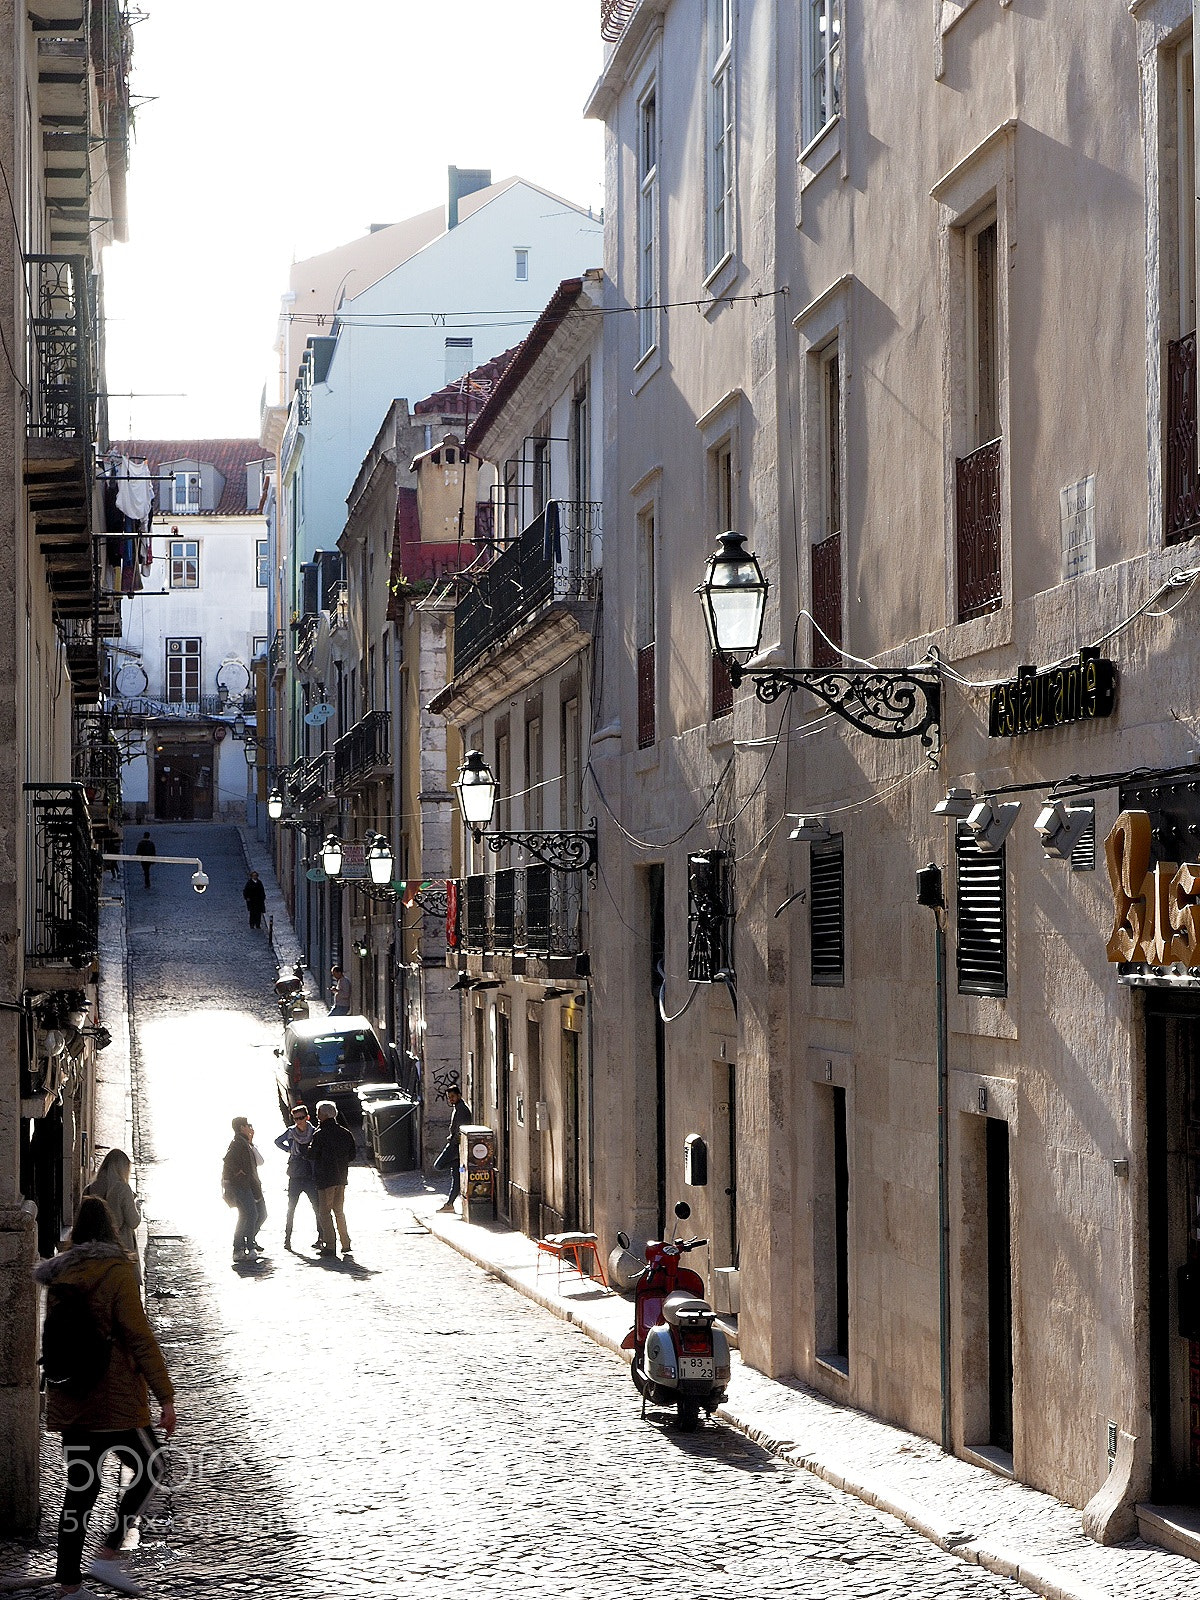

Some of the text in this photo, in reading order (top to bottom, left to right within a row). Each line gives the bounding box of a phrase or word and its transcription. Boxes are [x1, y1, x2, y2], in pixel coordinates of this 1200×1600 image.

[988, 647, 1102, 738] restaurante
[690, 1358, 703, 1368] 83
[700, 1368, 713, 1378] 23
